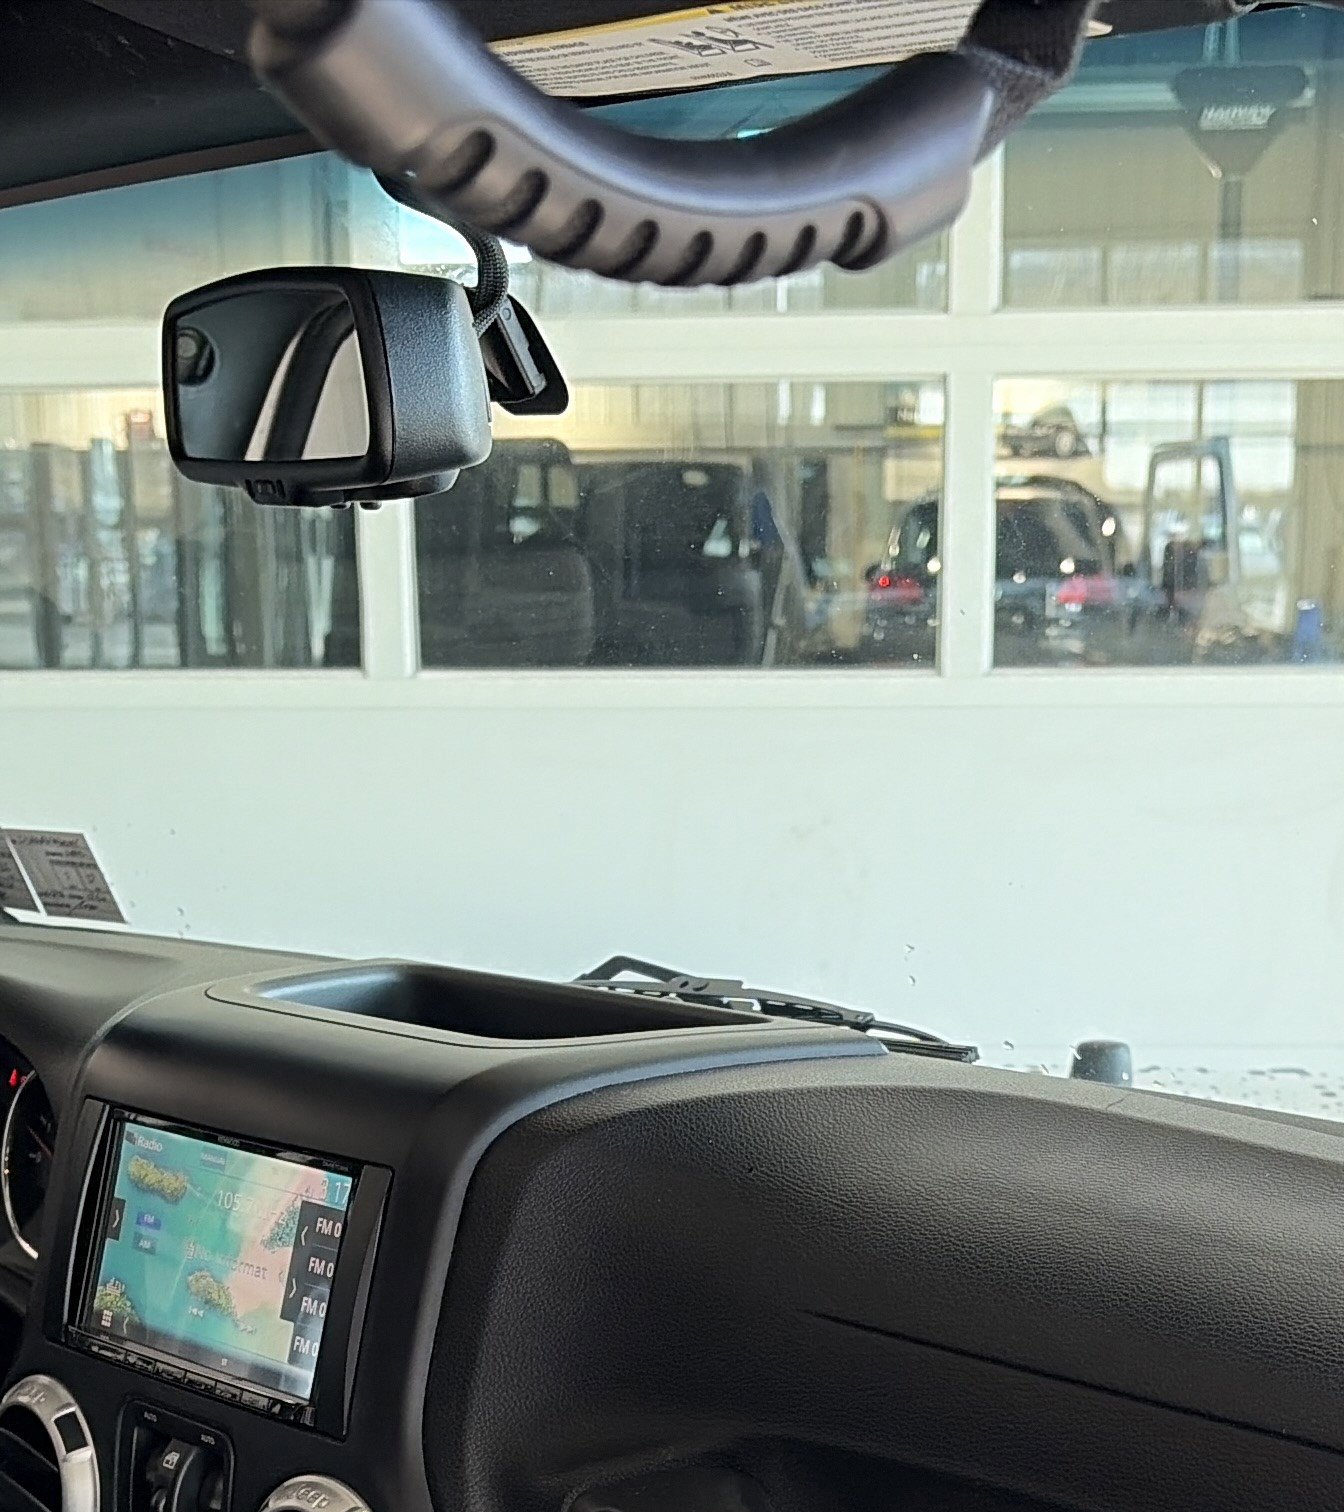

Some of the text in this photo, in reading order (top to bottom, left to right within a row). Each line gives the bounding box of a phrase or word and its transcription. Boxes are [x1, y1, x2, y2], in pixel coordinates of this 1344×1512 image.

[316, 1217, 332, 1235] FM
[308, 1256, 326, 1276] FM
[300, 1296, 318, 1316] FM
[293, 1336, 310, 1354] FM
